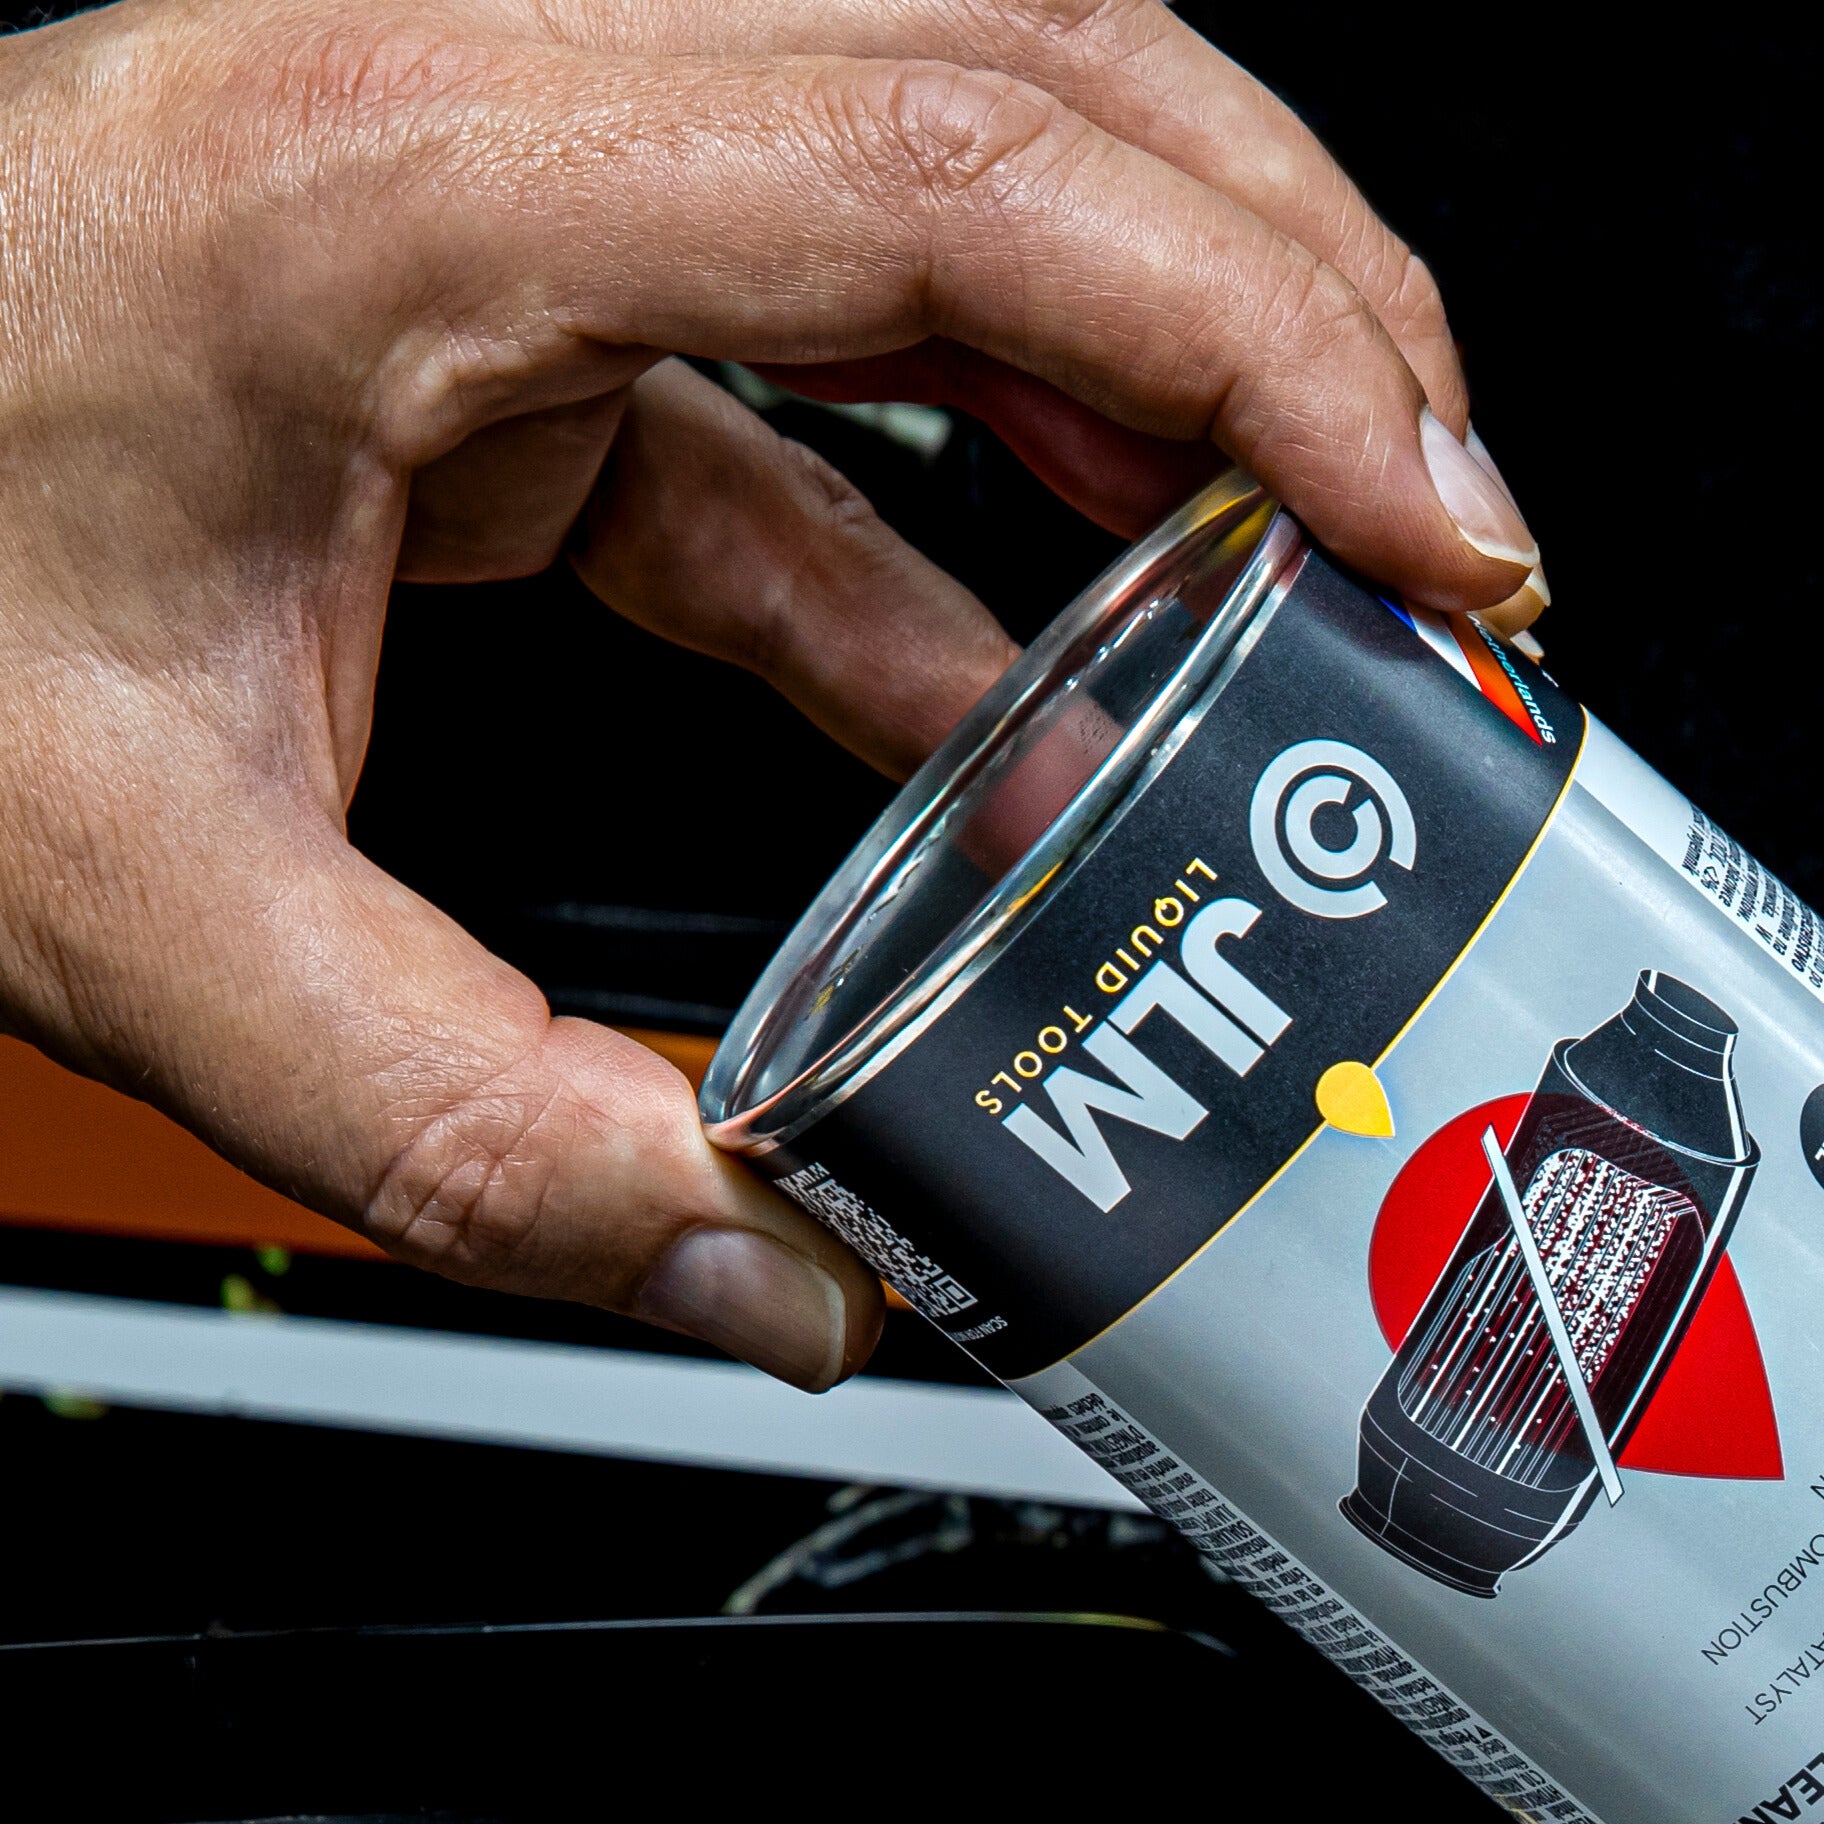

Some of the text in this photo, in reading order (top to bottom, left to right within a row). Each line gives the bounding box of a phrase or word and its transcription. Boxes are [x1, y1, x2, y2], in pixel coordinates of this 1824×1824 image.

[1680, 825, 1703, 879] pojemnik
[974, 855, 1217, 1116] LIQUID TOOLS
[999, 899, 1293, 1213] JLM
[976, 1314, 1008, 1336] SCAN
